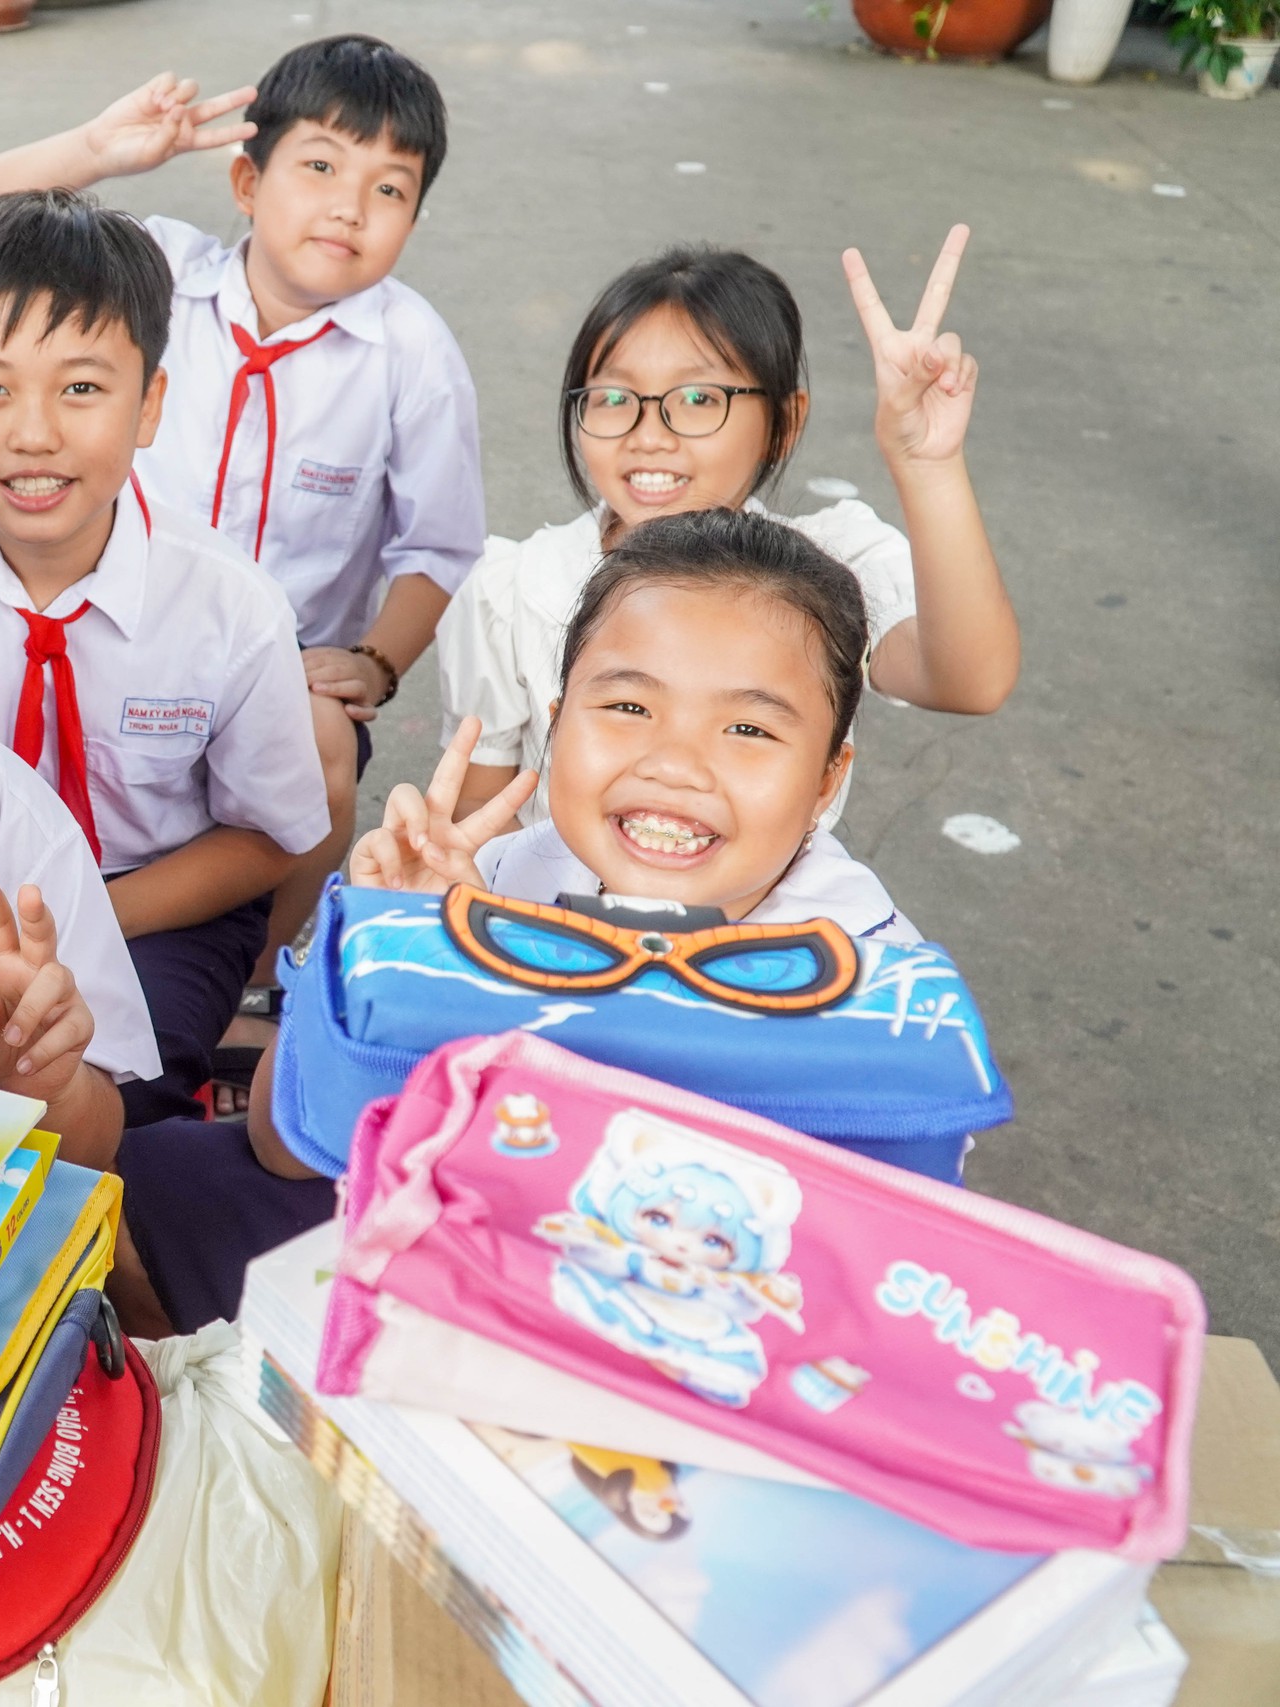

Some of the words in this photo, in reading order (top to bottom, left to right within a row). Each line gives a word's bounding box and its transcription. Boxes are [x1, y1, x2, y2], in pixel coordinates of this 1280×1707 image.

[128, 708, 147, 718] NAM
[5, 1214, 18, 1242] 12
[875, 1259, 1163, 1438] SUNSHINE
[56, 1406, 89, 1441] GIÁO
[46, 1439, 86, 1487] BÔNG
[28, 1479, 66, 1520] SEN
[19, 1505, 43, 1530] 1
